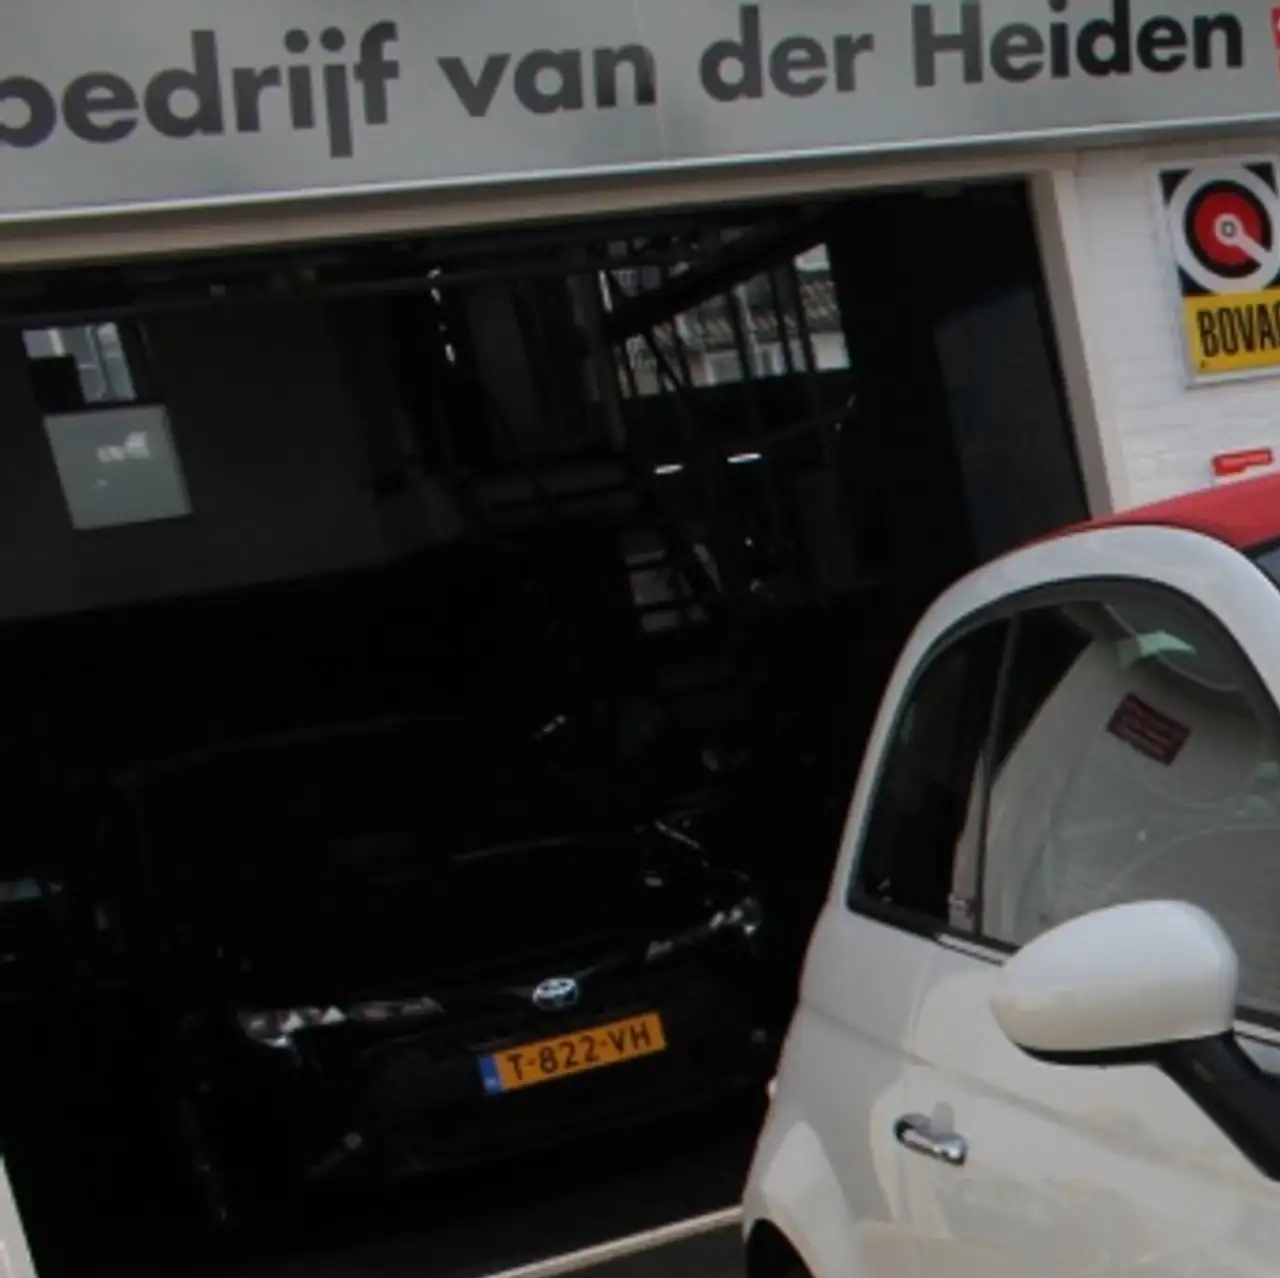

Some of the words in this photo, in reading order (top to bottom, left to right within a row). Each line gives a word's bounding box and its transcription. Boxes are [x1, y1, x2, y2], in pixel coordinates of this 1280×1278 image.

[437, 42, 658, 118] van
[700, 5, 874, 101] der
[912, 0, 1244, 86] Heiden
[507, 1021, 650, 1081] T-822-VH
